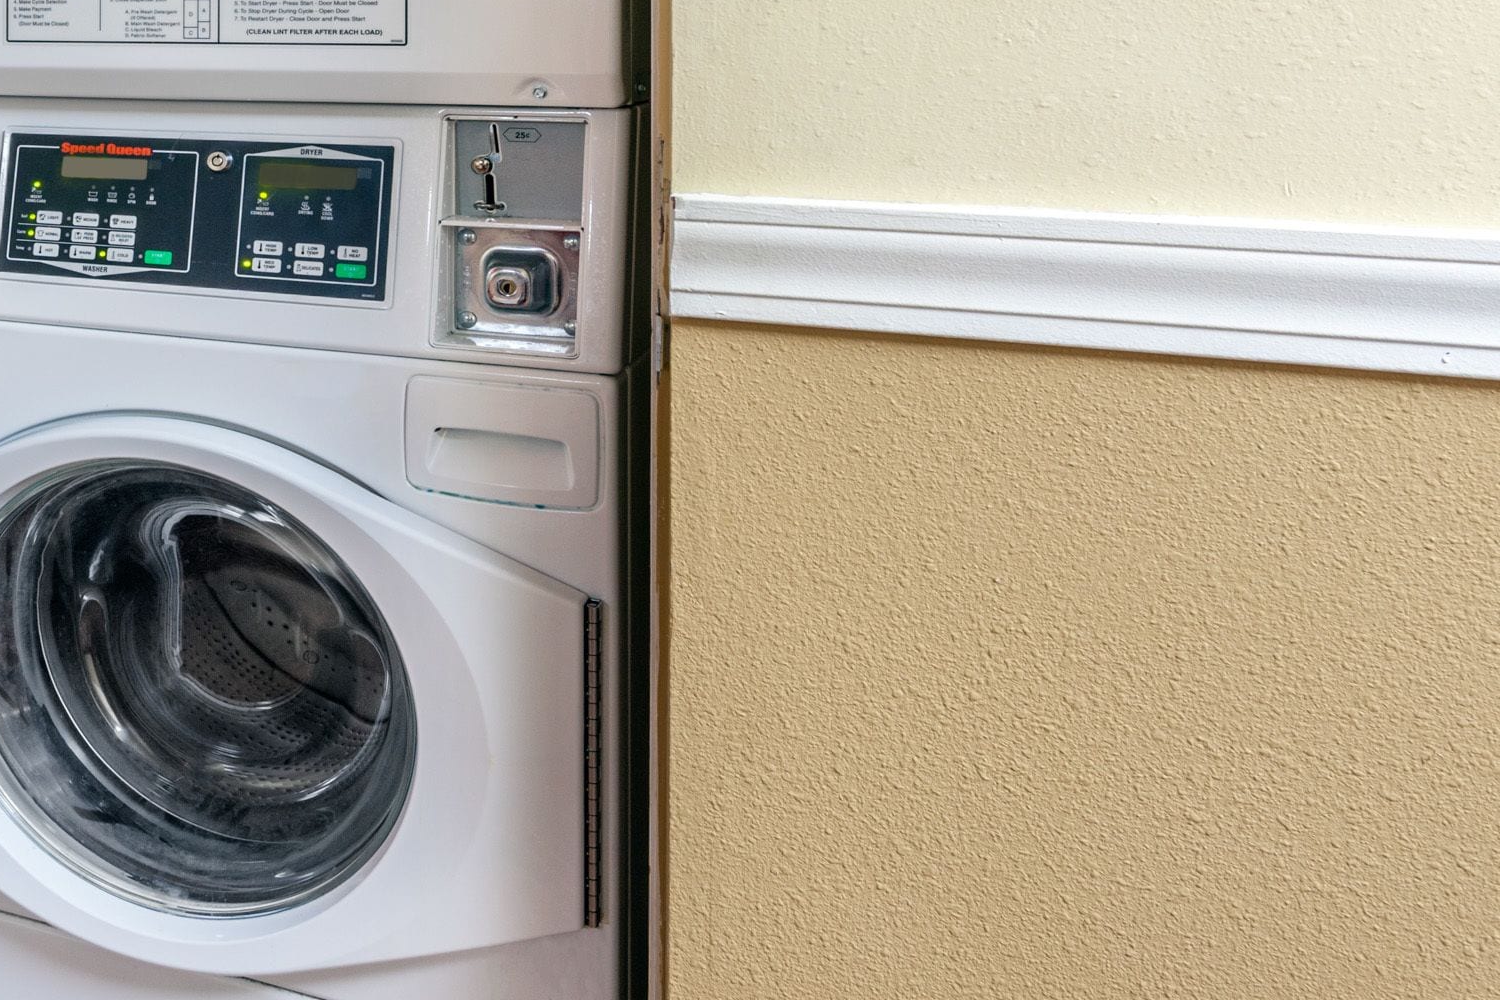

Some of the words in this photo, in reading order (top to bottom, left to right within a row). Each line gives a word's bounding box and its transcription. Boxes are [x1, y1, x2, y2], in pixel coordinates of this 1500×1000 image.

[61, 142, 105, 155] Speed
[106, 143, 152, 156] Queen
[82, 265, 108, 273] WASHER
